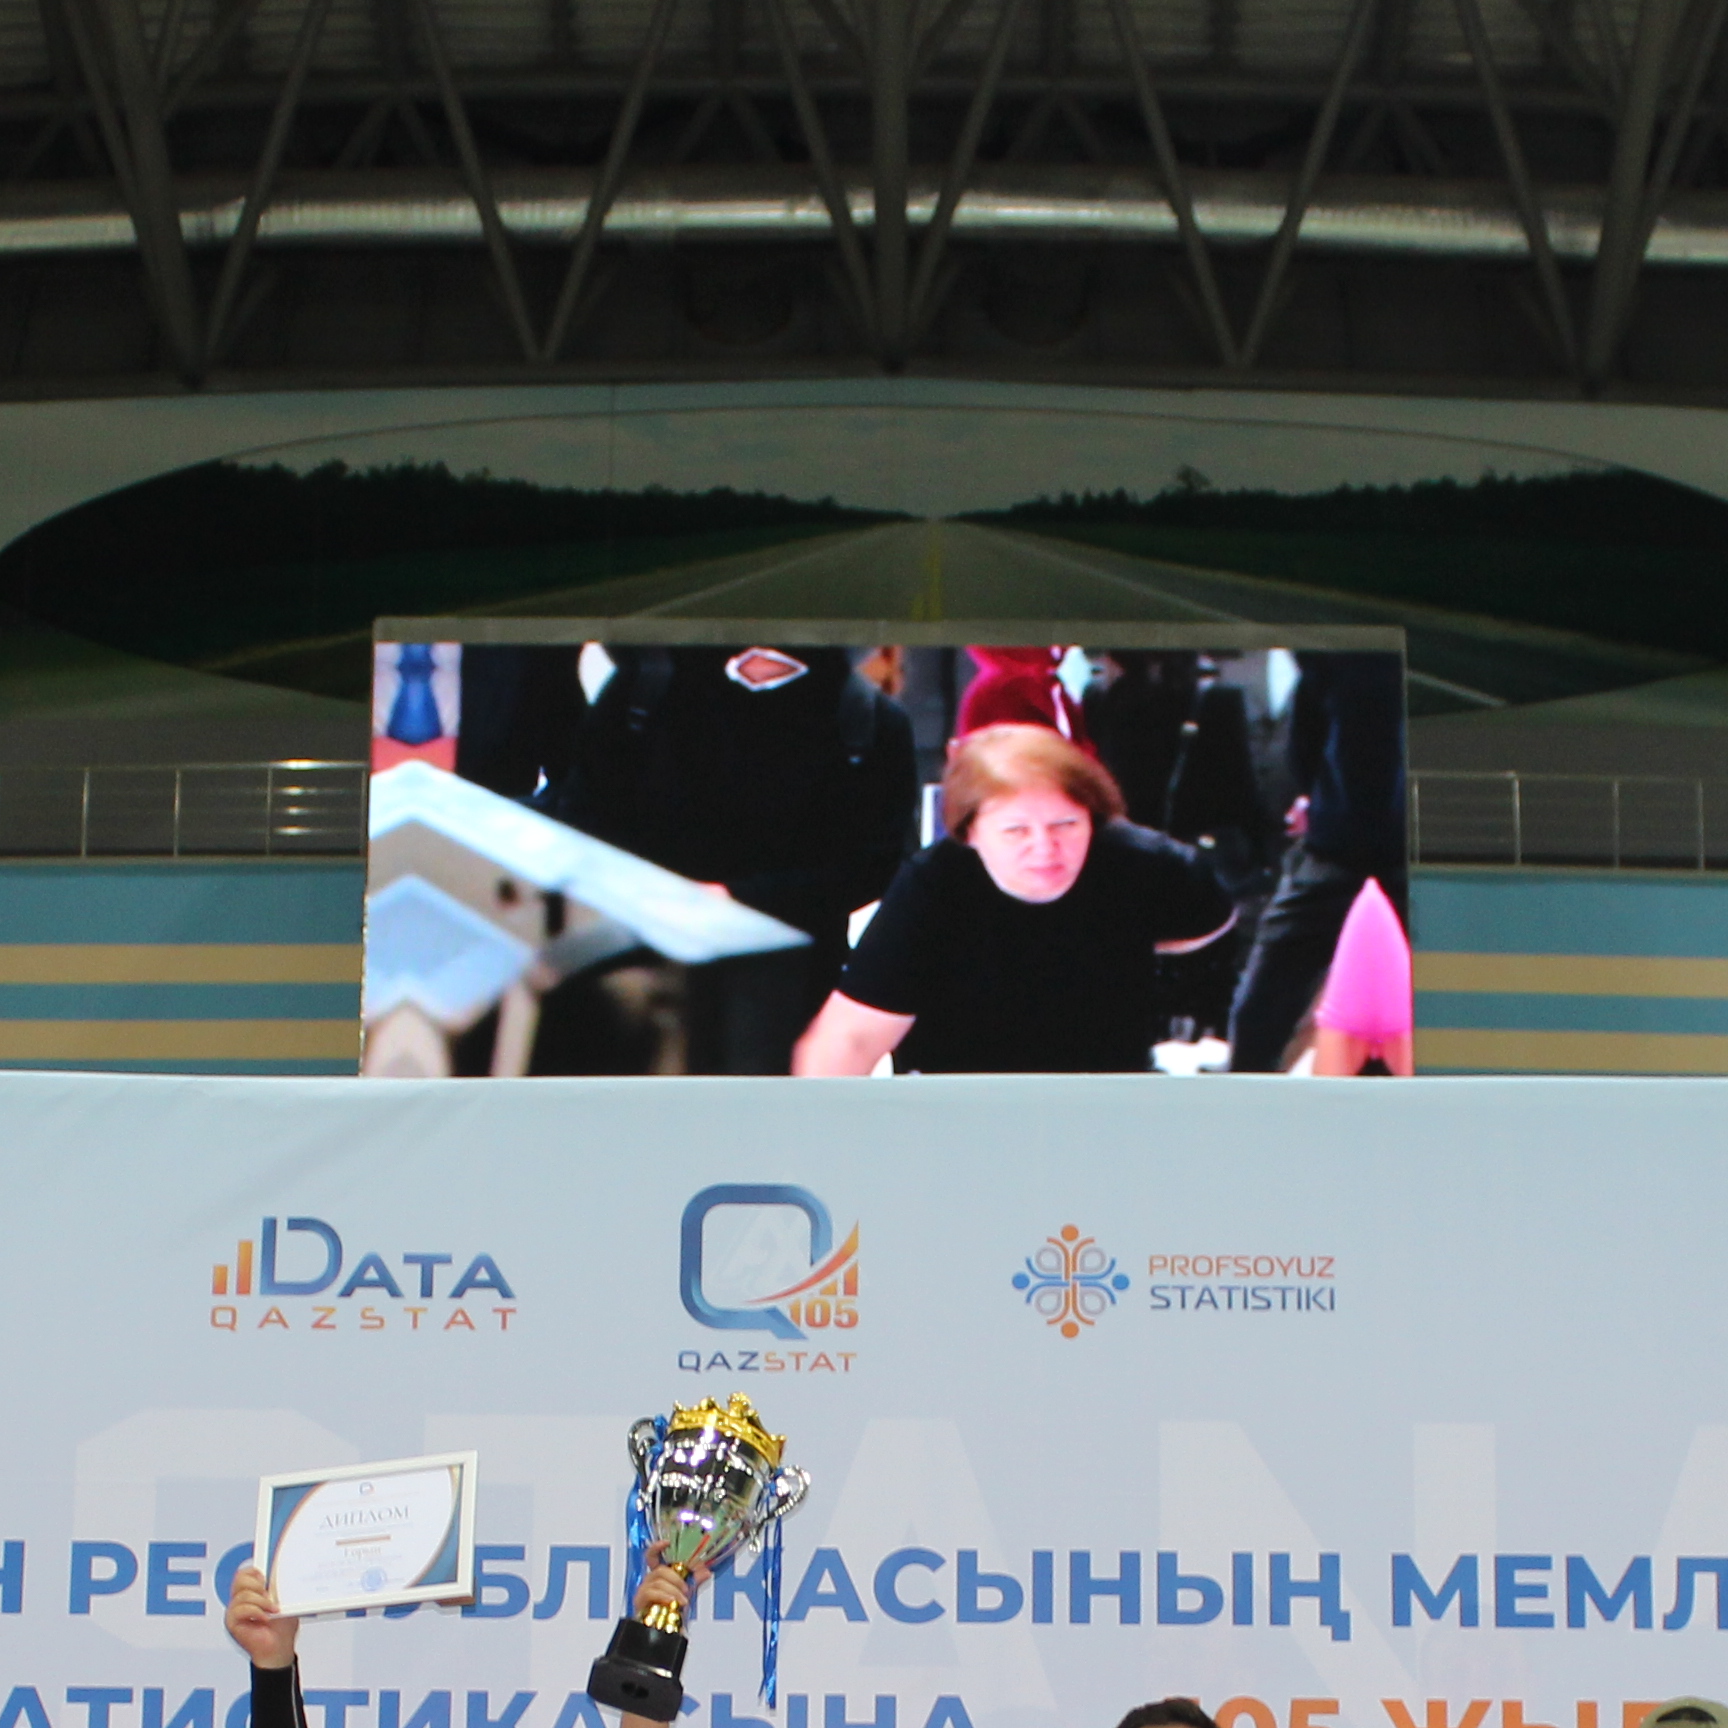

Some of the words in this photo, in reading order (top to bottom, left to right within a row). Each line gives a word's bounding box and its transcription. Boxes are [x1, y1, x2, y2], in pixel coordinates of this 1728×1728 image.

[1148, 1254, 1336, 1279] PROFSOYUZ
[1149, 1285, 1336, 1312] STATISTIKI
[210, 1305, 517, 1332] QAZSTAT
[677, 1349, 858, 1374] QAZSTAT
